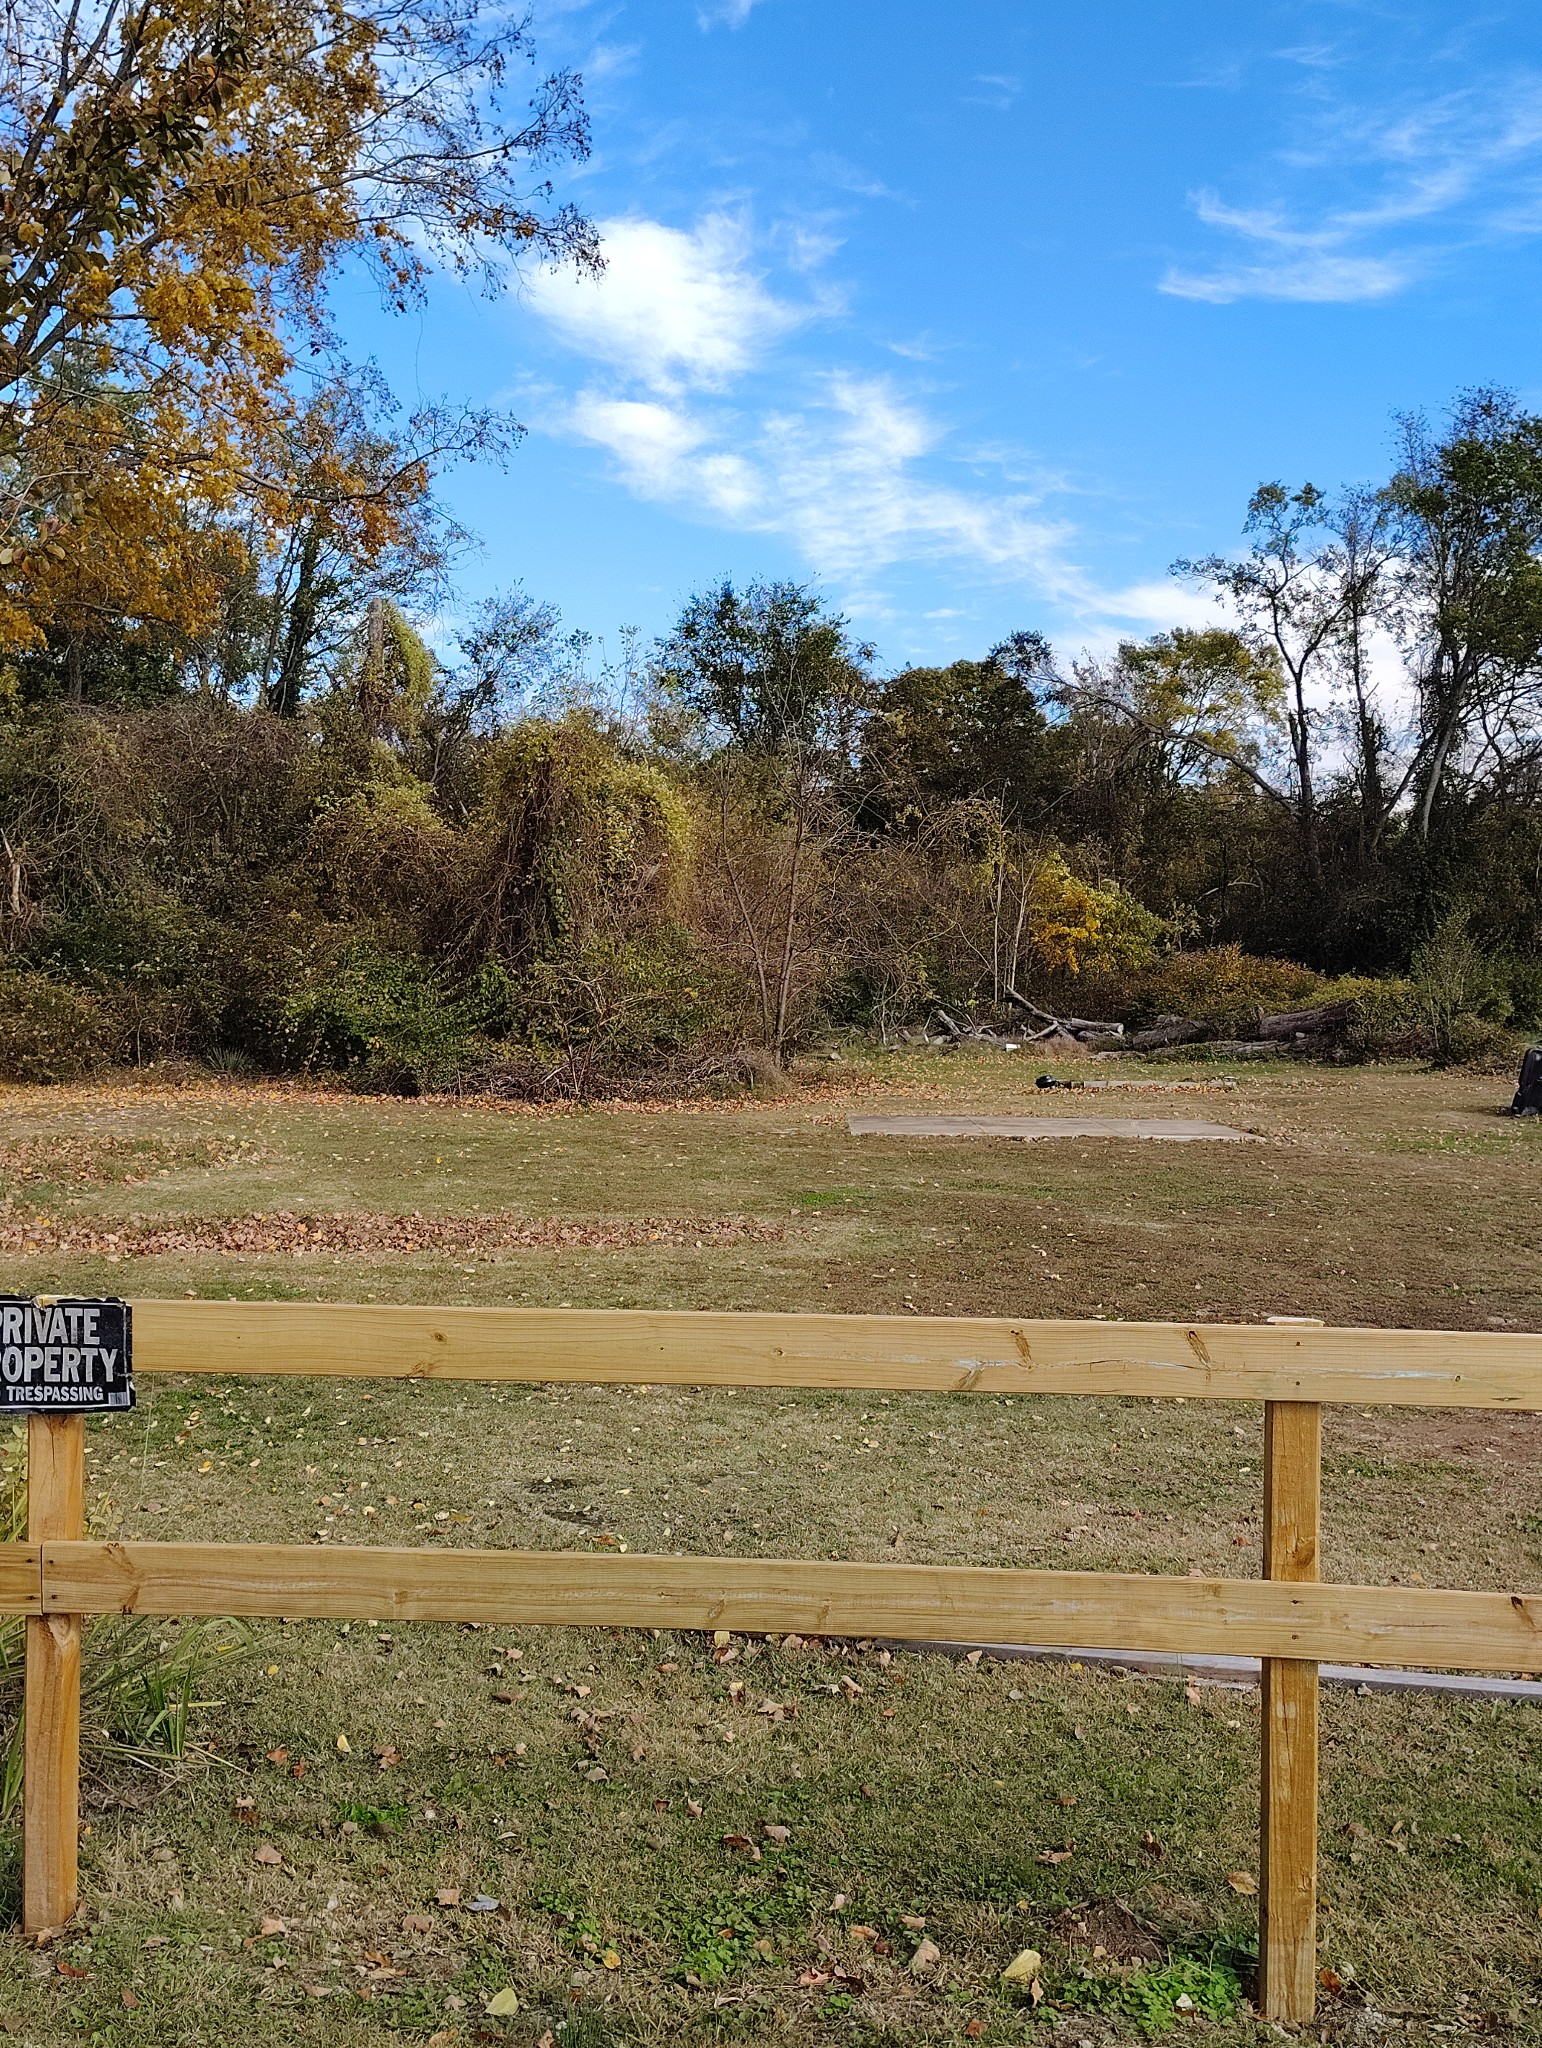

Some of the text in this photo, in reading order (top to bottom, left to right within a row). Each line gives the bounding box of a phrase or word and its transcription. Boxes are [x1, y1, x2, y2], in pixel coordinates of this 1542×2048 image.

[0, 1307, 100, 1345] RIVATE
[0, 1346, 118, 1382] OPERTY
[6, 1386, 104, 1401] TRESPASSING
